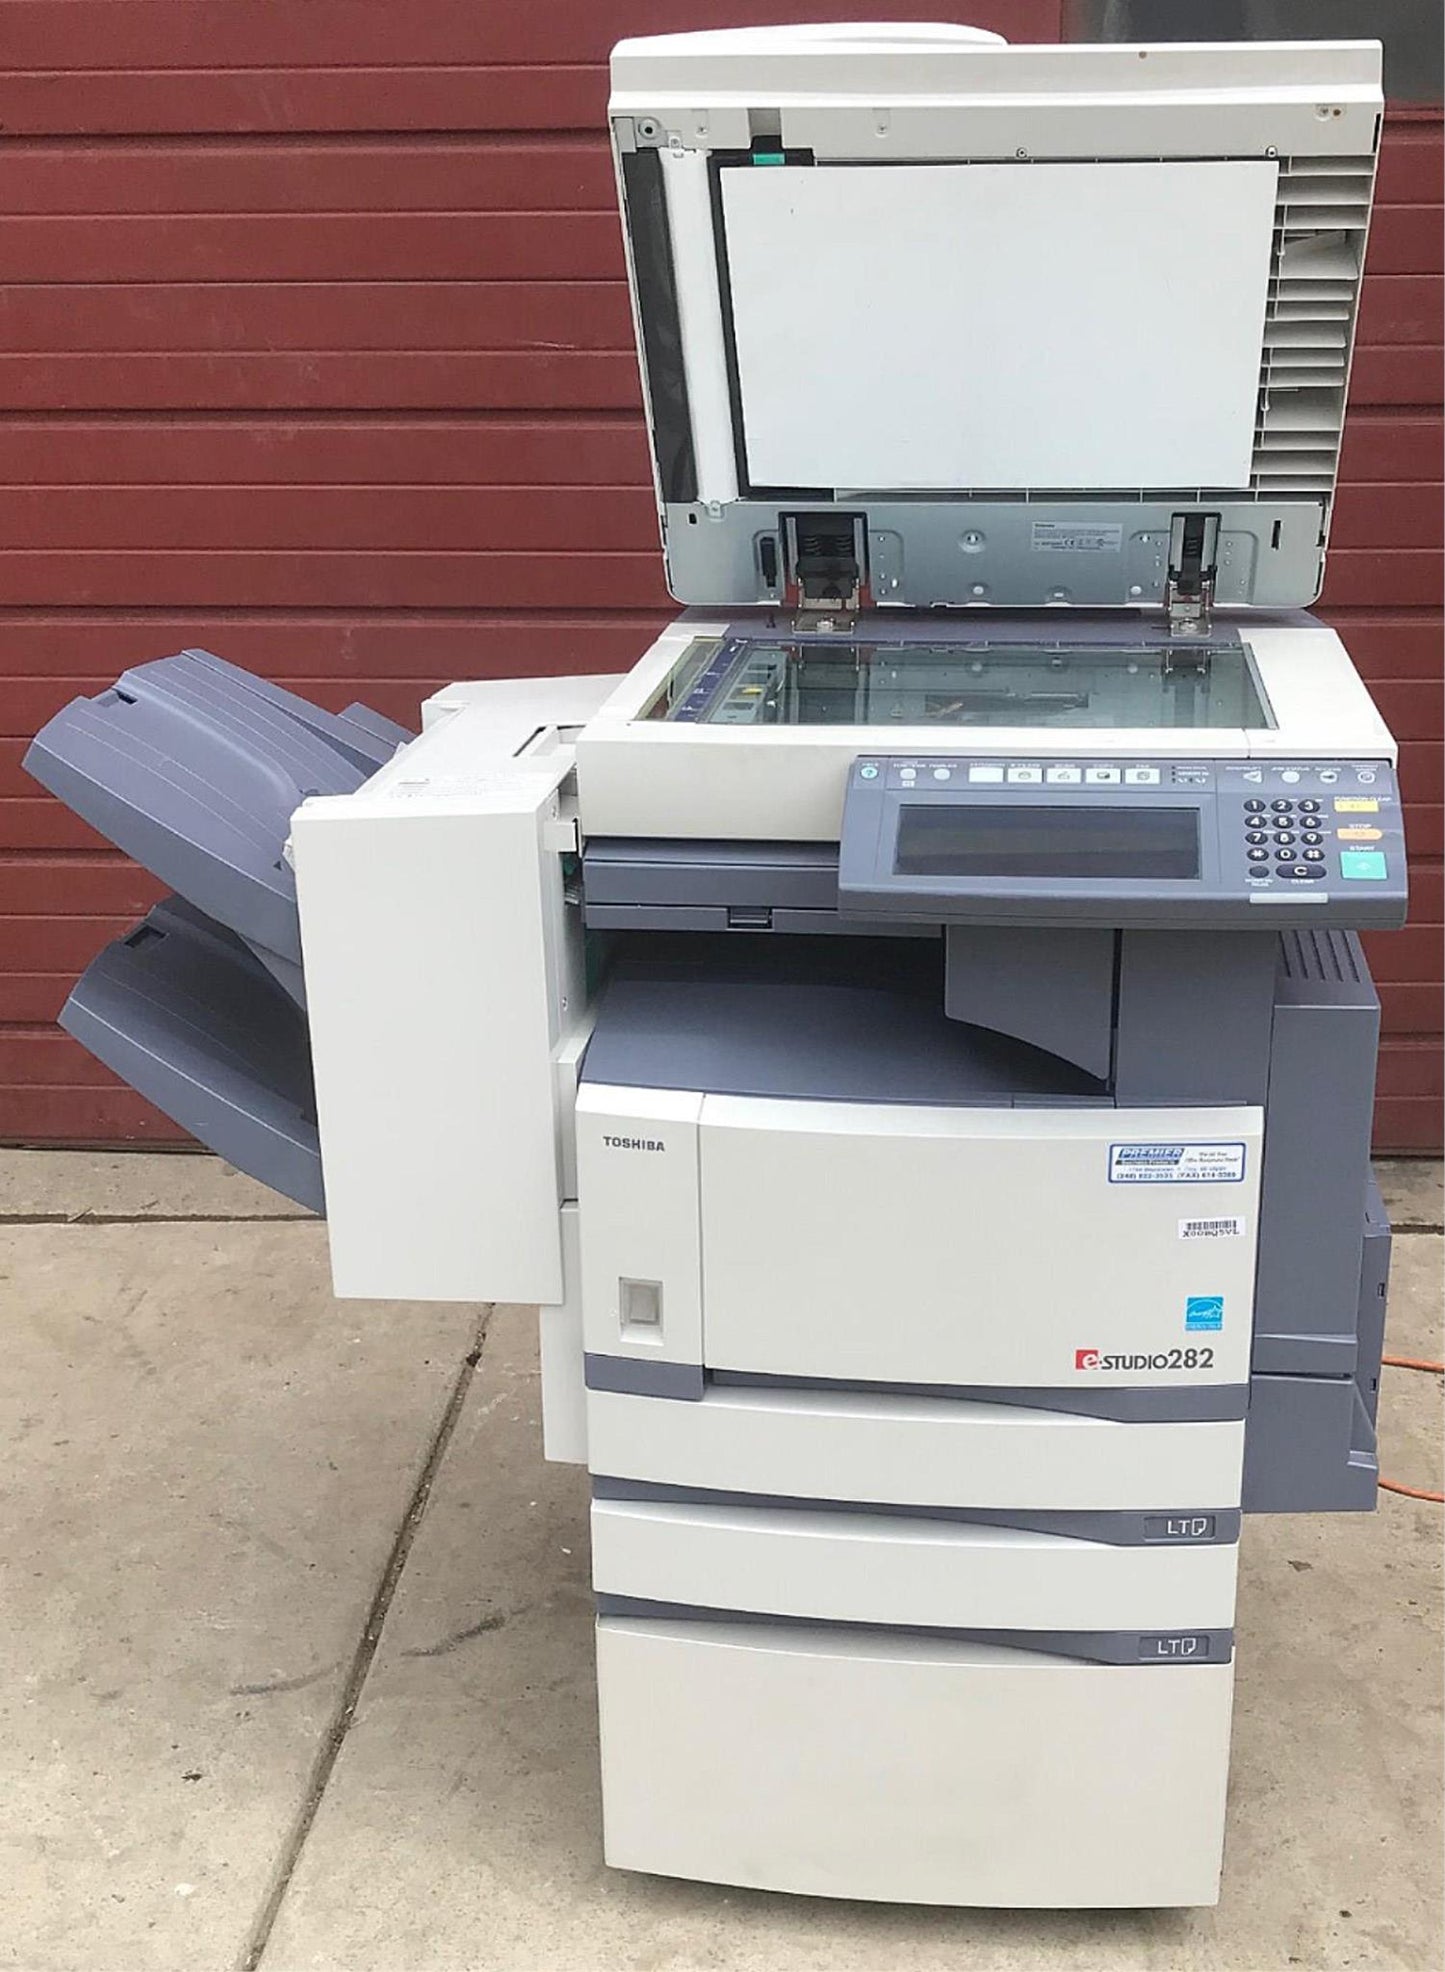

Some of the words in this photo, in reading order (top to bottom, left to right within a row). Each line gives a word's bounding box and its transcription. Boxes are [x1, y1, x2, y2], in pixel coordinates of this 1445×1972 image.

[1251, 800, 1258, 810] 1
[1277, 800, 1287, 810] 2
[1304, 800, 1314, 811] 3
[1250, 817, 1260, 825] 4
[1278, 817, 1288, 826] 5
[1305, 817, 1315, 826] 6
[1252, 833, 1262, 842] 7
[1280, 833, 1290, 843] 8
[1306, 833, 1317, 843] 9
[1280, 849, 1291, 859] 0
[1294, 866, 1307, 876] C
[602, 1135, 665, 1152] TOSHIBA
[1120, 1147, 1183, 1158] PREMIER
[1176, 1171, 1200, 1179] (FAX)
